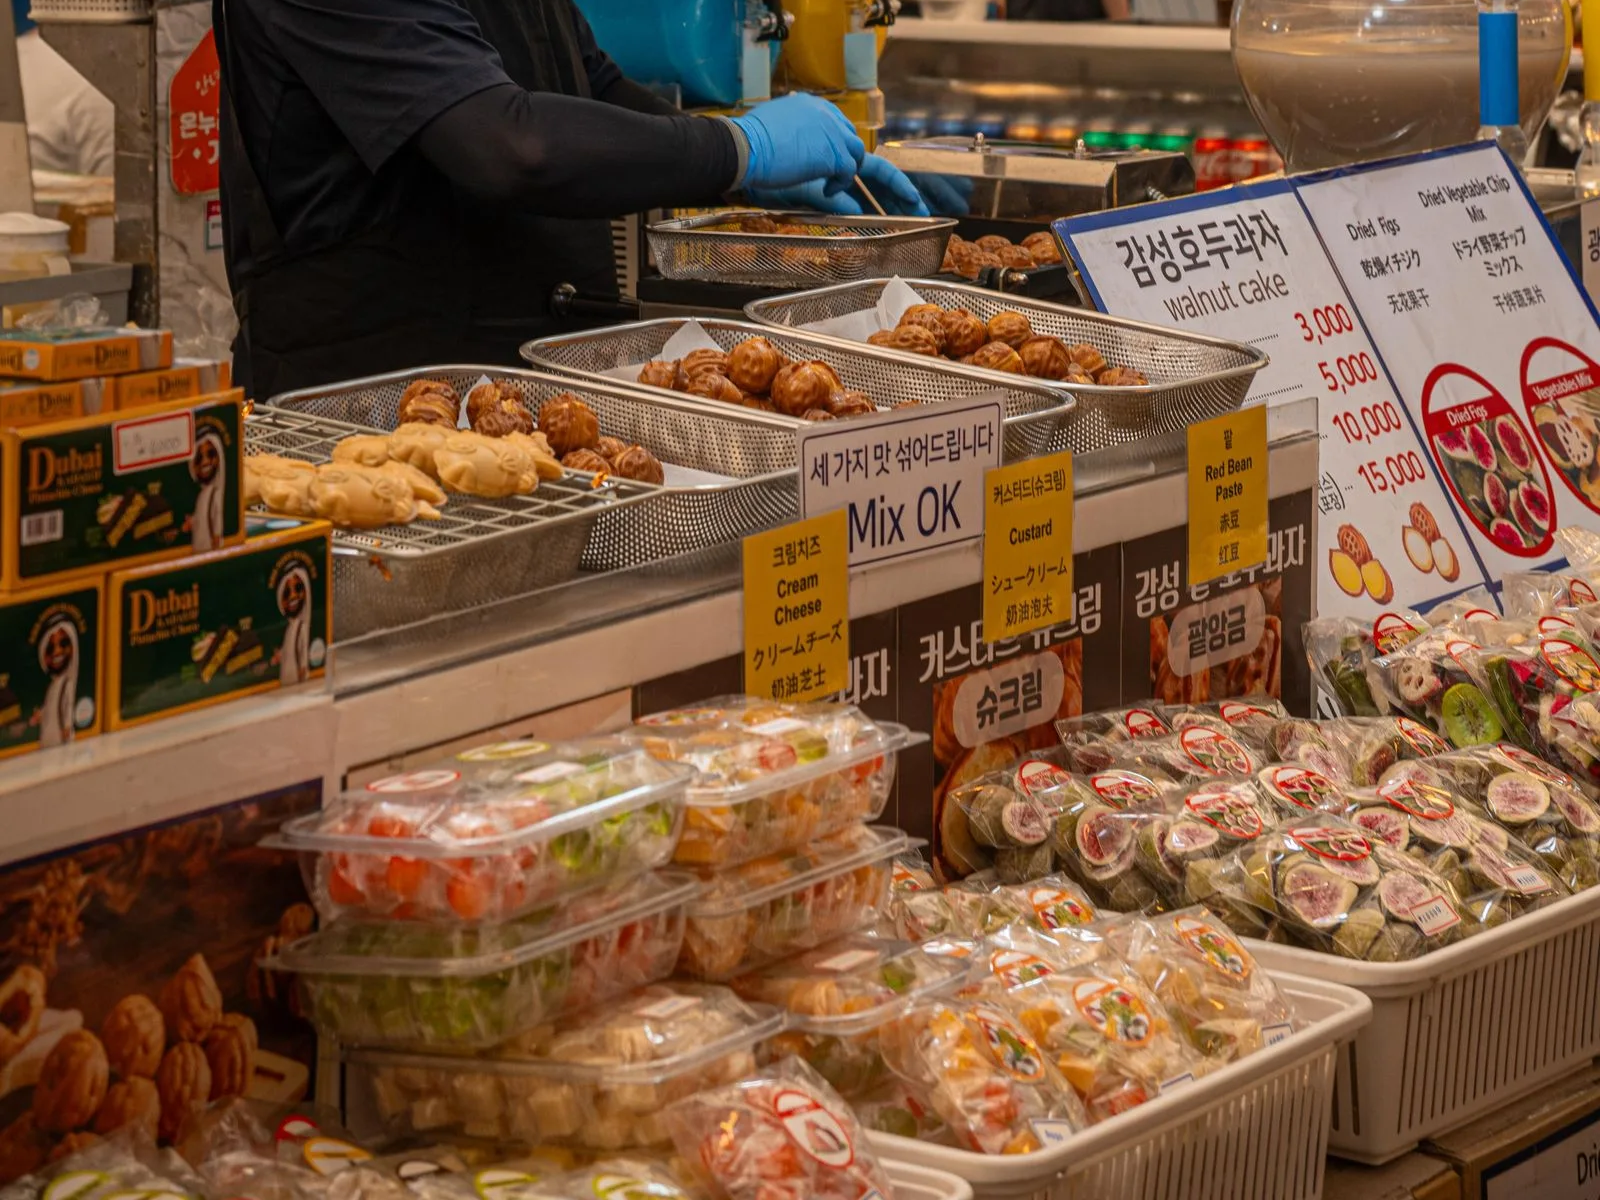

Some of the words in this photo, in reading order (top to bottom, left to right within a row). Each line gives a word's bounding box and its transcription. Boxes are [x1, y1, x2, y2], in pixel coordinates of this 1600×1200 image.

[180, 109, 220, 139] 온누
[1418, 190, 1446, 208] Dried
[1443, 180, 1488, 203] Vegetable
[1486, 174, 1510, 194] Chip
[1346, 218, 1376, 241] Dried
[1378, 216, 1401, 236] Figs
[1465, 206, 1487, 224] Mix
[1115, 209, 1289, 289] 감성호두과자
[1453, 226, 1527, 260] ドライ野菜チップ
[1360, 248, 1421, 280] 乾燥イチジク
[1484, 255, 1524, 278] ミックス
[1163, 281, 1239, 323] walnut
[1238, 270, 1290, 305] cake
[1294, 303, 1354, 345] 3,000
[1318, 351, 1378, 394] 5,000
[1532, 377, 1577, 401] Vegetables
[1575, 371, 1594, 388] Mix
[1332, 401, 1402, 445] 10,000
[1446, 408, 1469, 426] Dried
[1469, 405, 1488, 422] Figs
[811, 453, 829, 487] 세
[834, 445, 868, 482] 가지
[874, 441, 891, 476] 맛
[895, 421, 994, 473] 섞어드립니다
[1223, 428, 1233, 450] 팥
[28, 443, 102, 492] Dubai
[1206, 462, 1225, 482] Red
[1228, 455, 1252, 476] Bean
[1358, 450, 1426, 495] 15,000
[993, 468, 1066, 505] 커스터드(슈크림)
[1216, 483, 1243, 502] Paste
[849, 495, 905, 553] Mix
[917, 479, 962, 537] OK
[1010, 518, 1053, 545] Custard
[772, 535, 822, 568] 크림치즈
[777, 573, 819, 599] Cream
[991, 556, 1067, 595] シュークリーム
[1135, 560, 1180, 619] 감성
[129, 582, 199, 632] Dubai
[775, 599, 822, 626] Cheese
[753, 619, 843, 671] クリームチーズ
[1188, 604, 1247, 659] 팥앙금
[772, 663, 826, 700] 奶油芝士
[976, 668, 1043, 728] 슈크림
